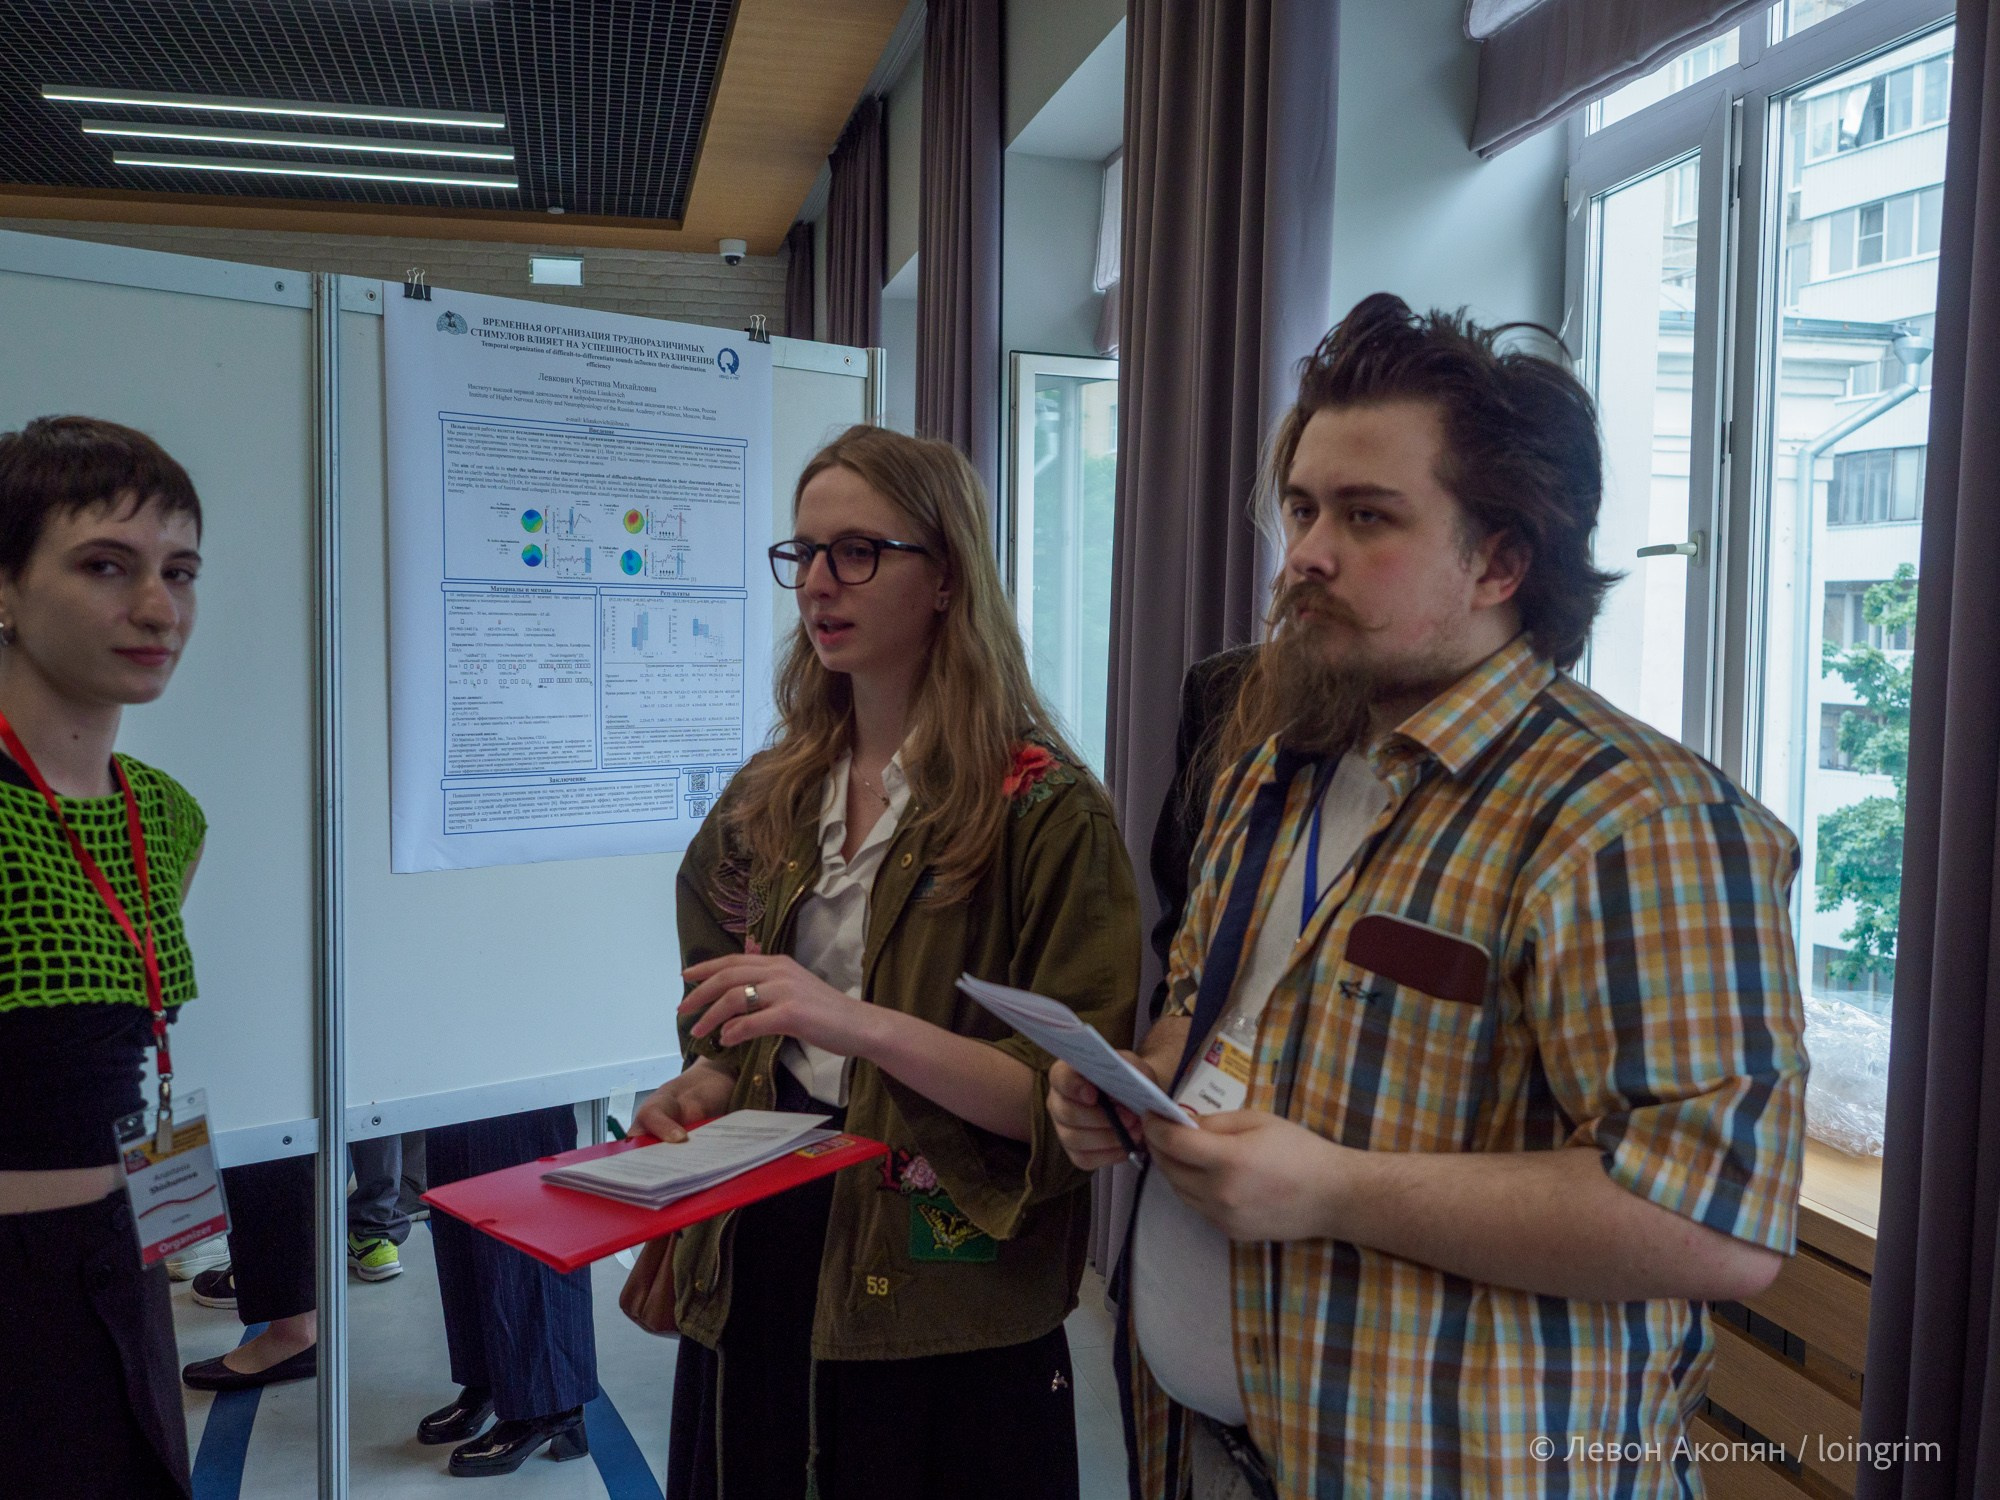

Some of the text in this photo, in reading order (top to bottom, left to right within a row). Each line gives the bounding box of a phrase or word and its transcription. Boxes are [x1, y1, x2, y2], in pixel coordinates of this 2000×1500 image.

[483, 317, 705, 355] ВРЕМЕННАЯ ОРГАНИЗАЦИЯ ТРУДНОРАЗЛИЧИМЫХ
[470, 327, 715, 366] СТИМУЛОВ ВЛИЯЕТ НА УСПЕШНОСТЬ ИХ РАЗЛИЧЕНИЯ
[481, 340, 508, 351] Temporal
[510, 344, 544, 355] organization
[586, 361, 611, 371] efficiency
[538, 372, 657, 393] Левкович Кристина Михайловна
[490, 586, 525, 594] Материалы
[549, 775, 587, 784] Заключение
[866, 1275, 889, 1296] 53
